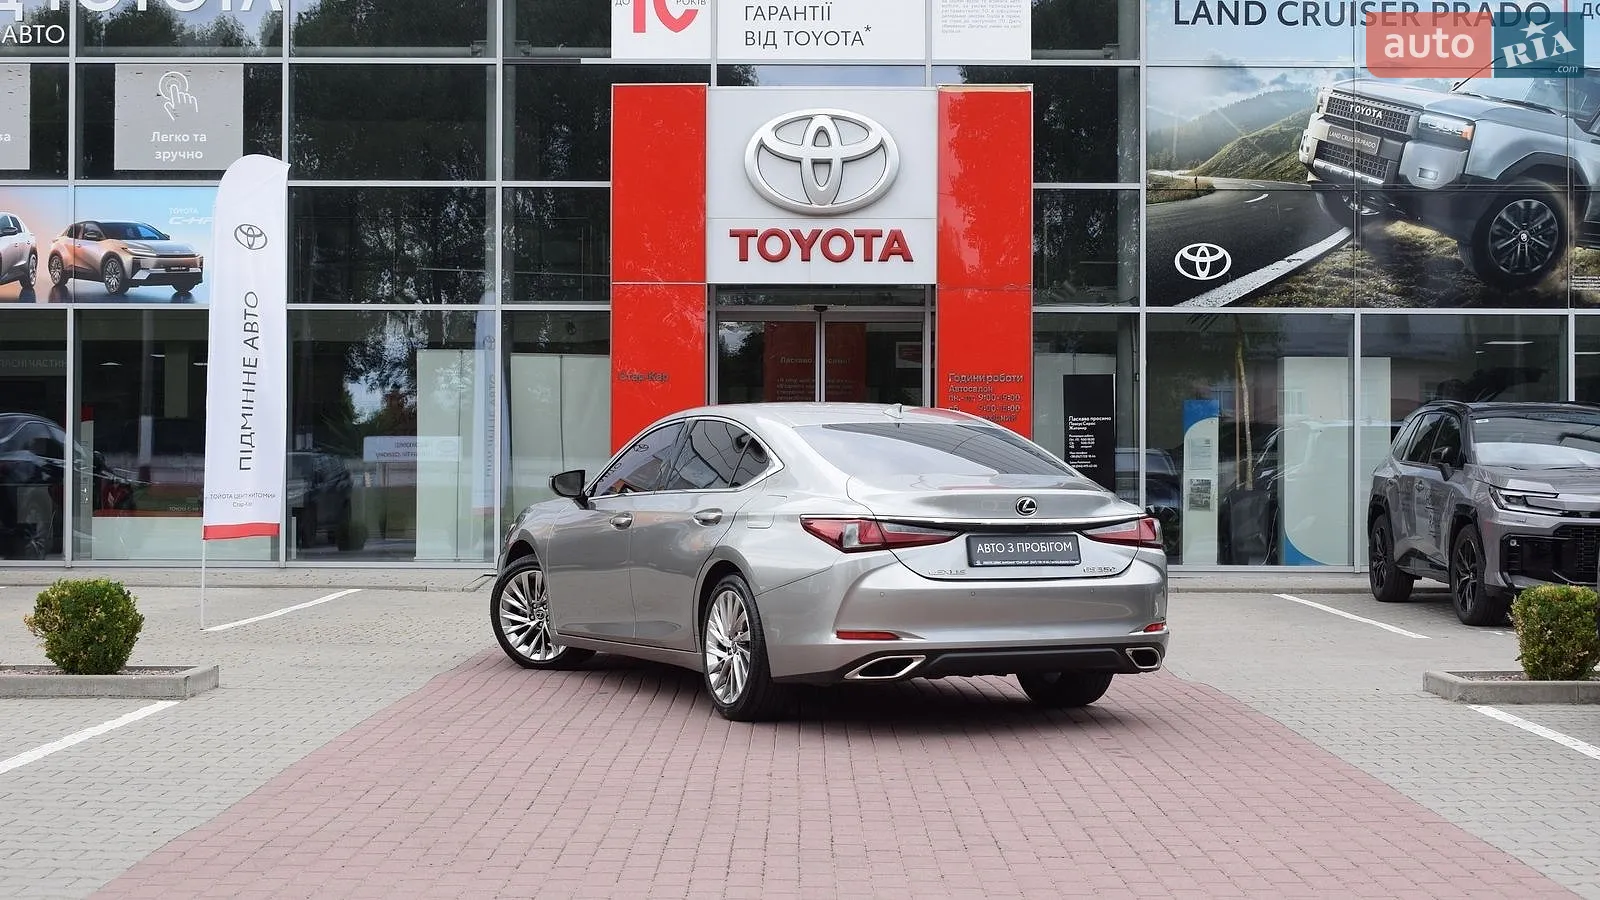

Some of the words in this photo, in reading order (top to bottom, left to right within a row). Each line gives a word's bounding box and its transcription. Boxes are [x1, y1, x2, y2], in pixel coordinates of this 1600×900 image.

[744, 2, 832, 21] ГАРАНТІЇ
[1173, 1, 1267, 26] LAND
[1277, 1, 1421, 27] CRUISER
[1432, 1, 1551, 27] PRADO
[2, 25, 65, 44] АВТО
[745, 30, 777, 49] ВІД
[1349, 105, 1382, 119] TOYOTA
[151, 132, 189, 143] Легко
[192, 133, 207, 142] та
[154, 150, 203, 161] зручно
[729, 228, 914, 263] TOYOTA
[243, 291, 260, 351] АВТО
[949, 373, 985, 383] Години
[986, 373, 1024, 384] роботи
[949, 384, 993, 393] Автосалон
[239, 357, 258, 471] ПІДМІННЕ
[976, 543, 1005, 553] АВТО
[1016, 541, 1073, 553] ПРОБІГОМ
